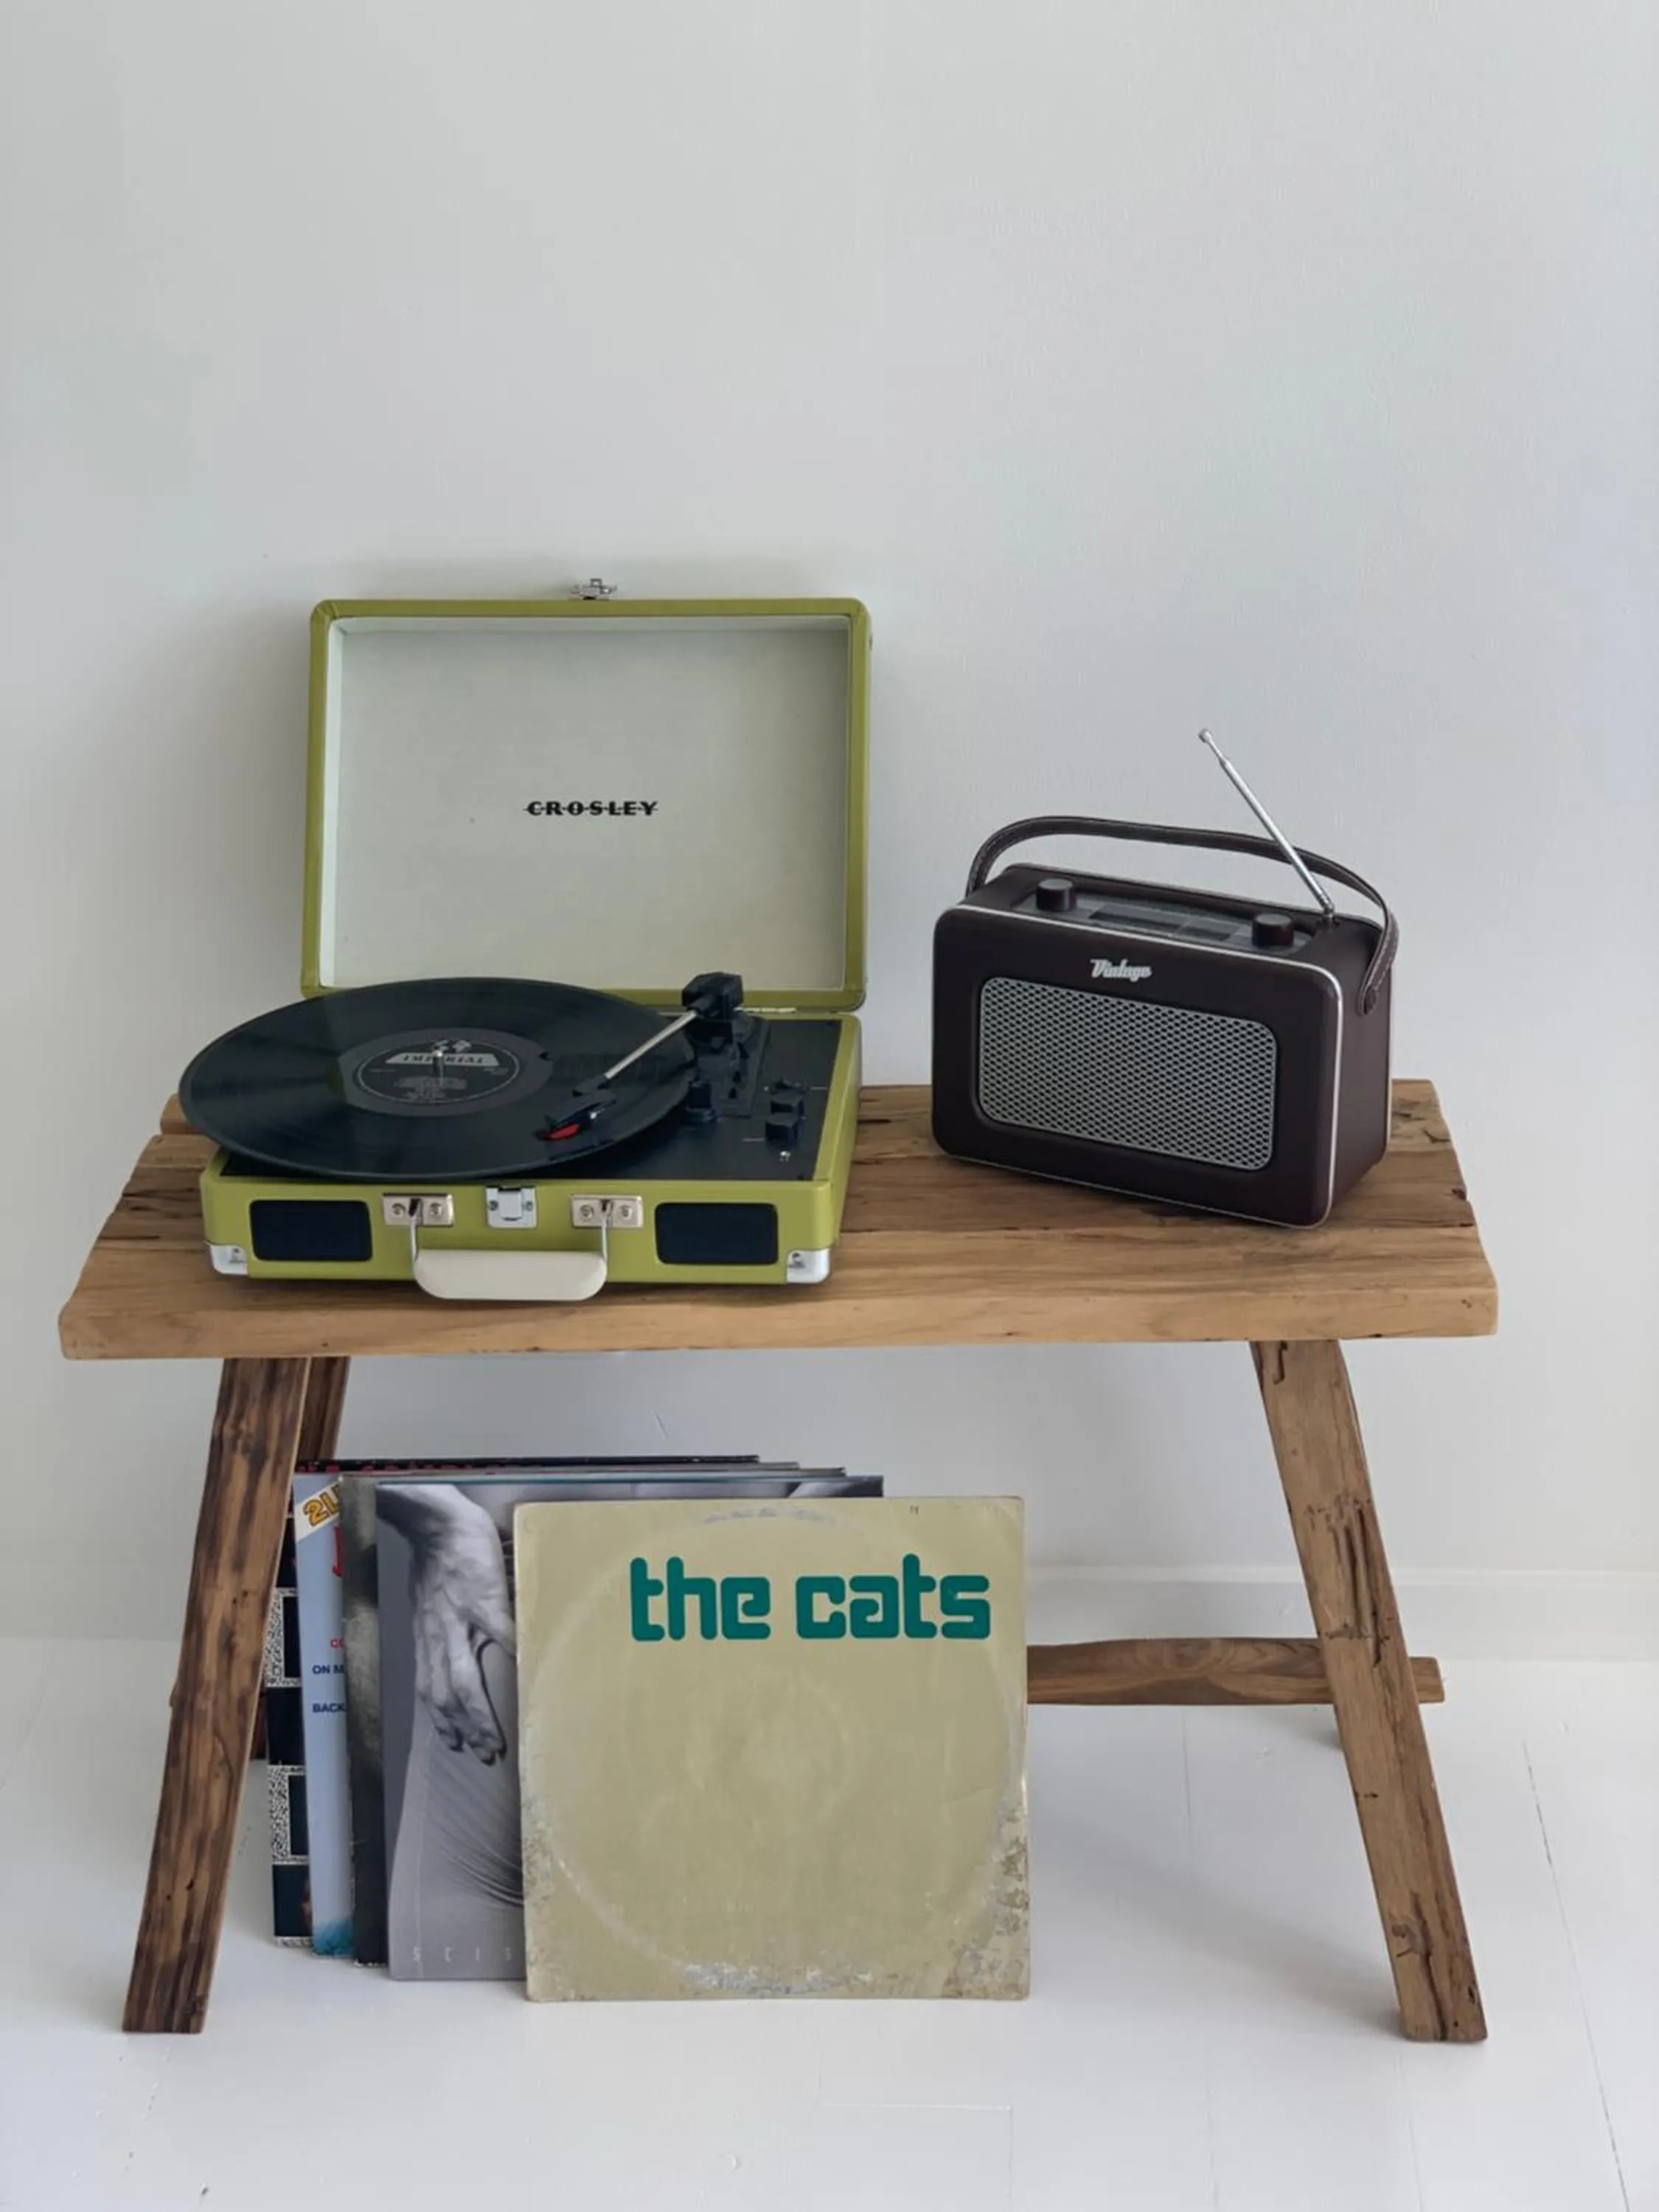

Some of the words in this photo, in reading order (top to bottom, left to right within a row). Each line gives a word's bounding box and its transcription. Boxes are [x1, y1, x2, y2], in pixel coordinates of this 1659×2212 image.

[524, 801, 658, 816] CROSLEY
[1090, 958, 1152, 982] Vintage
[403, 1054, 485, 1064] IMPRIAL
[630, 1557, 771, 1641] the
[796, 1554, 991, 1639] cats
[312, 1665, 330, 1674] ON
